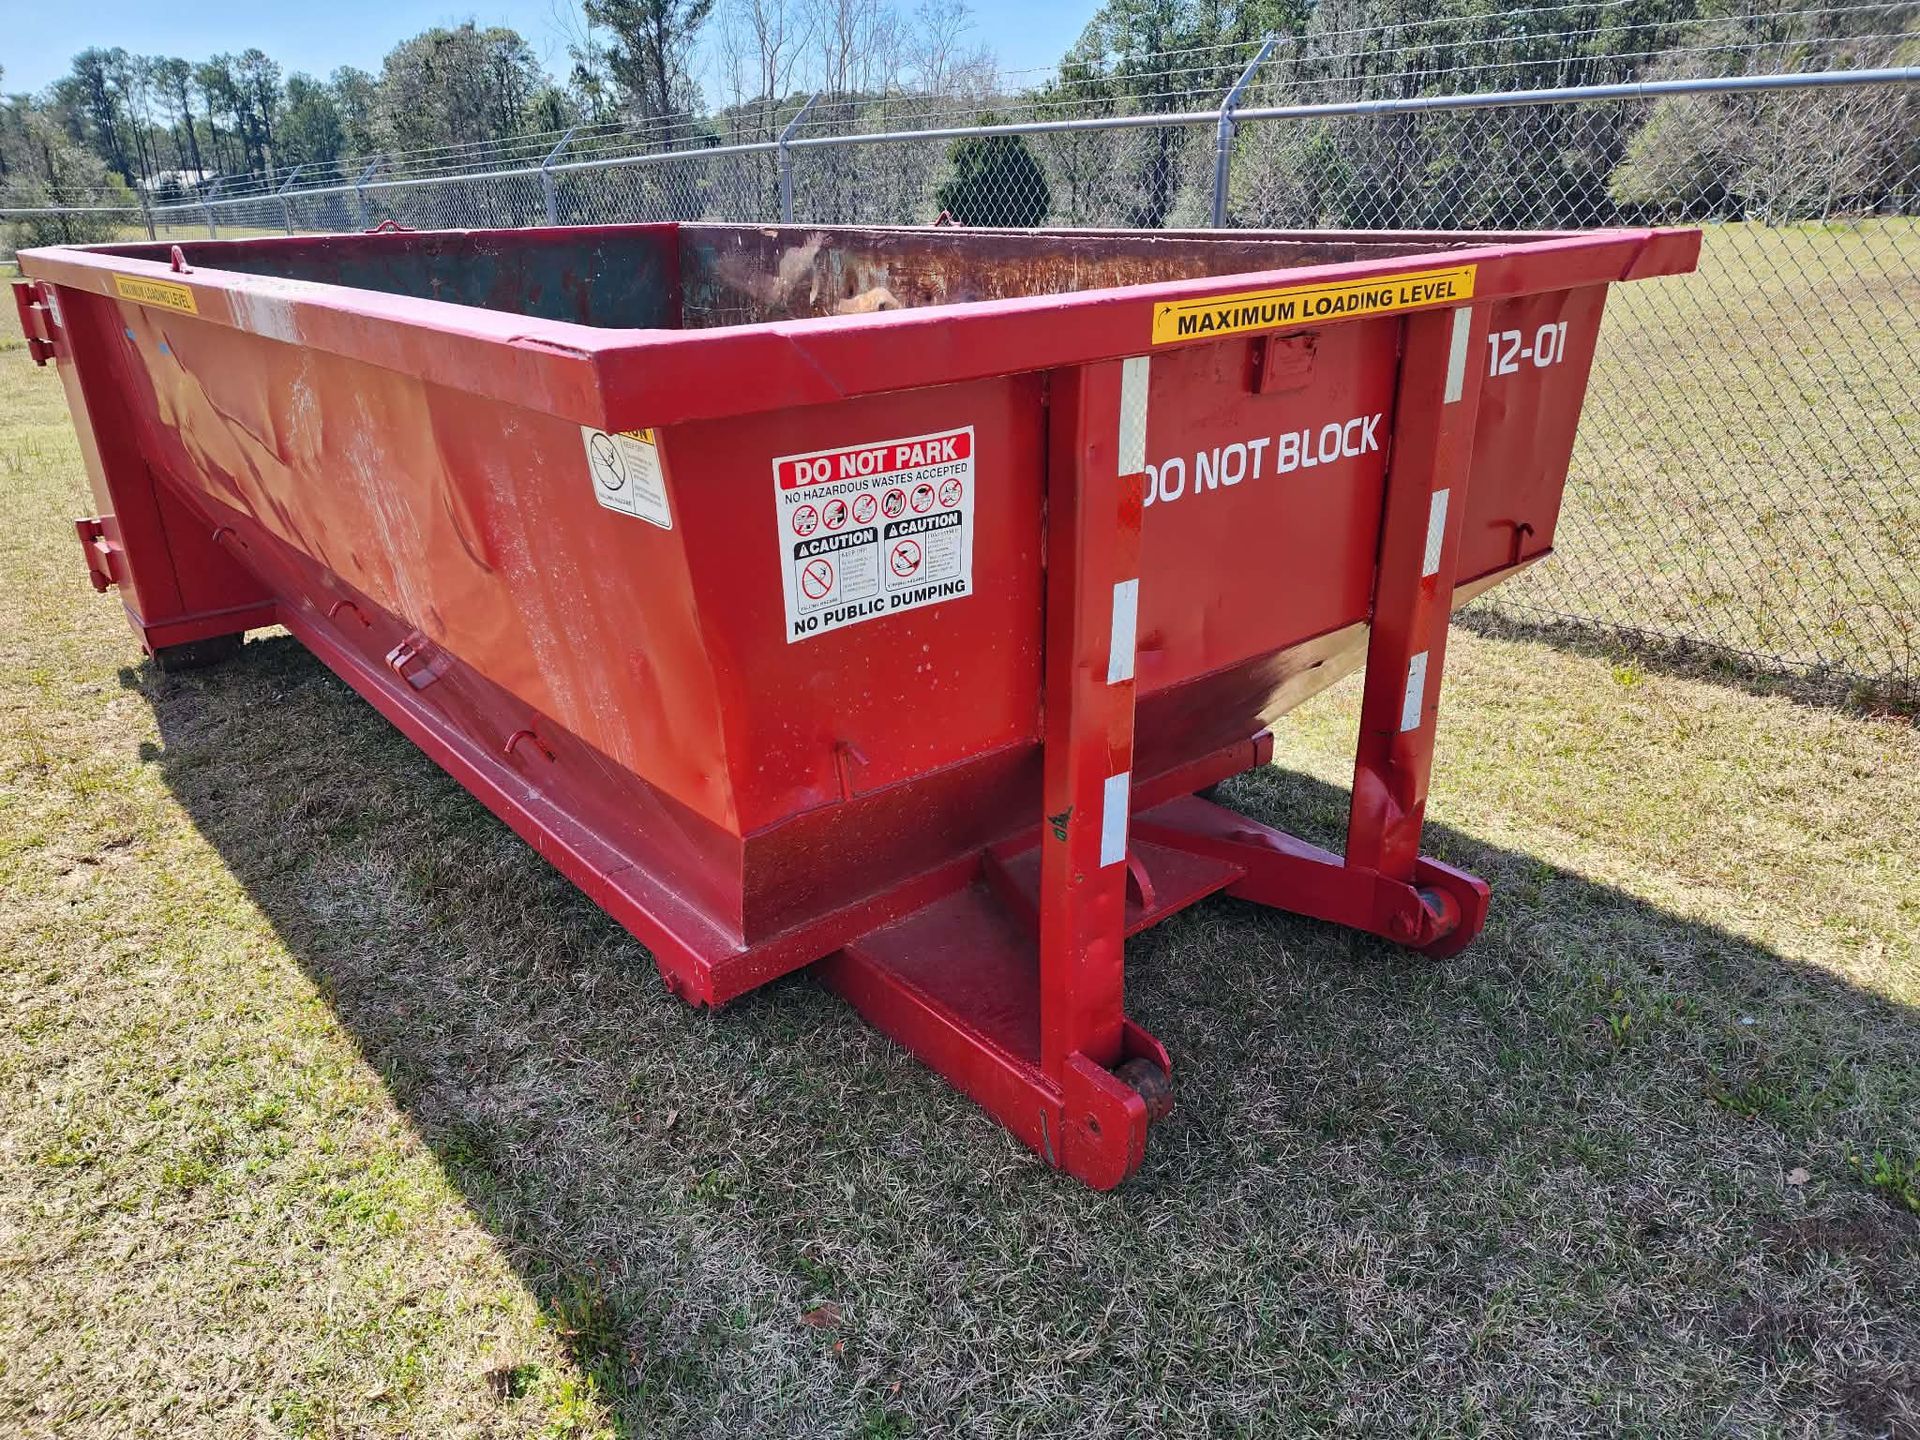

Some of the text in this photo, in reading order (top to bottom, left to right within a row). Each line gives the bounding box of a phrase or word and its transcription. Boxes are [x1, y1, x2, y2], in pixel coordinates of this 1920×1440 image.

[171, 291, 191, 309] LEVEL
[1177, 281, 1457, 336] MAXIMUM LOADING LEVEL
[1487, 321, 1568, 377] 12-01
[794, 437, 958, 487] DO NOT PARK
[1194, 437, 1270, 494] NOT
[1277, 413, 1382, 475] BLOCK
[785, 462, 968, 505] NO HAZARDOUS WASTES ACCEPTED
[806, 529, 875, 555] CAUTION
[899, 512, 959, 534] CAUTION
[794, 616, 819, 635] NO
[824, 598, 885, 627] PUBLIC
[891, 579, 966, 609] DUMPING
